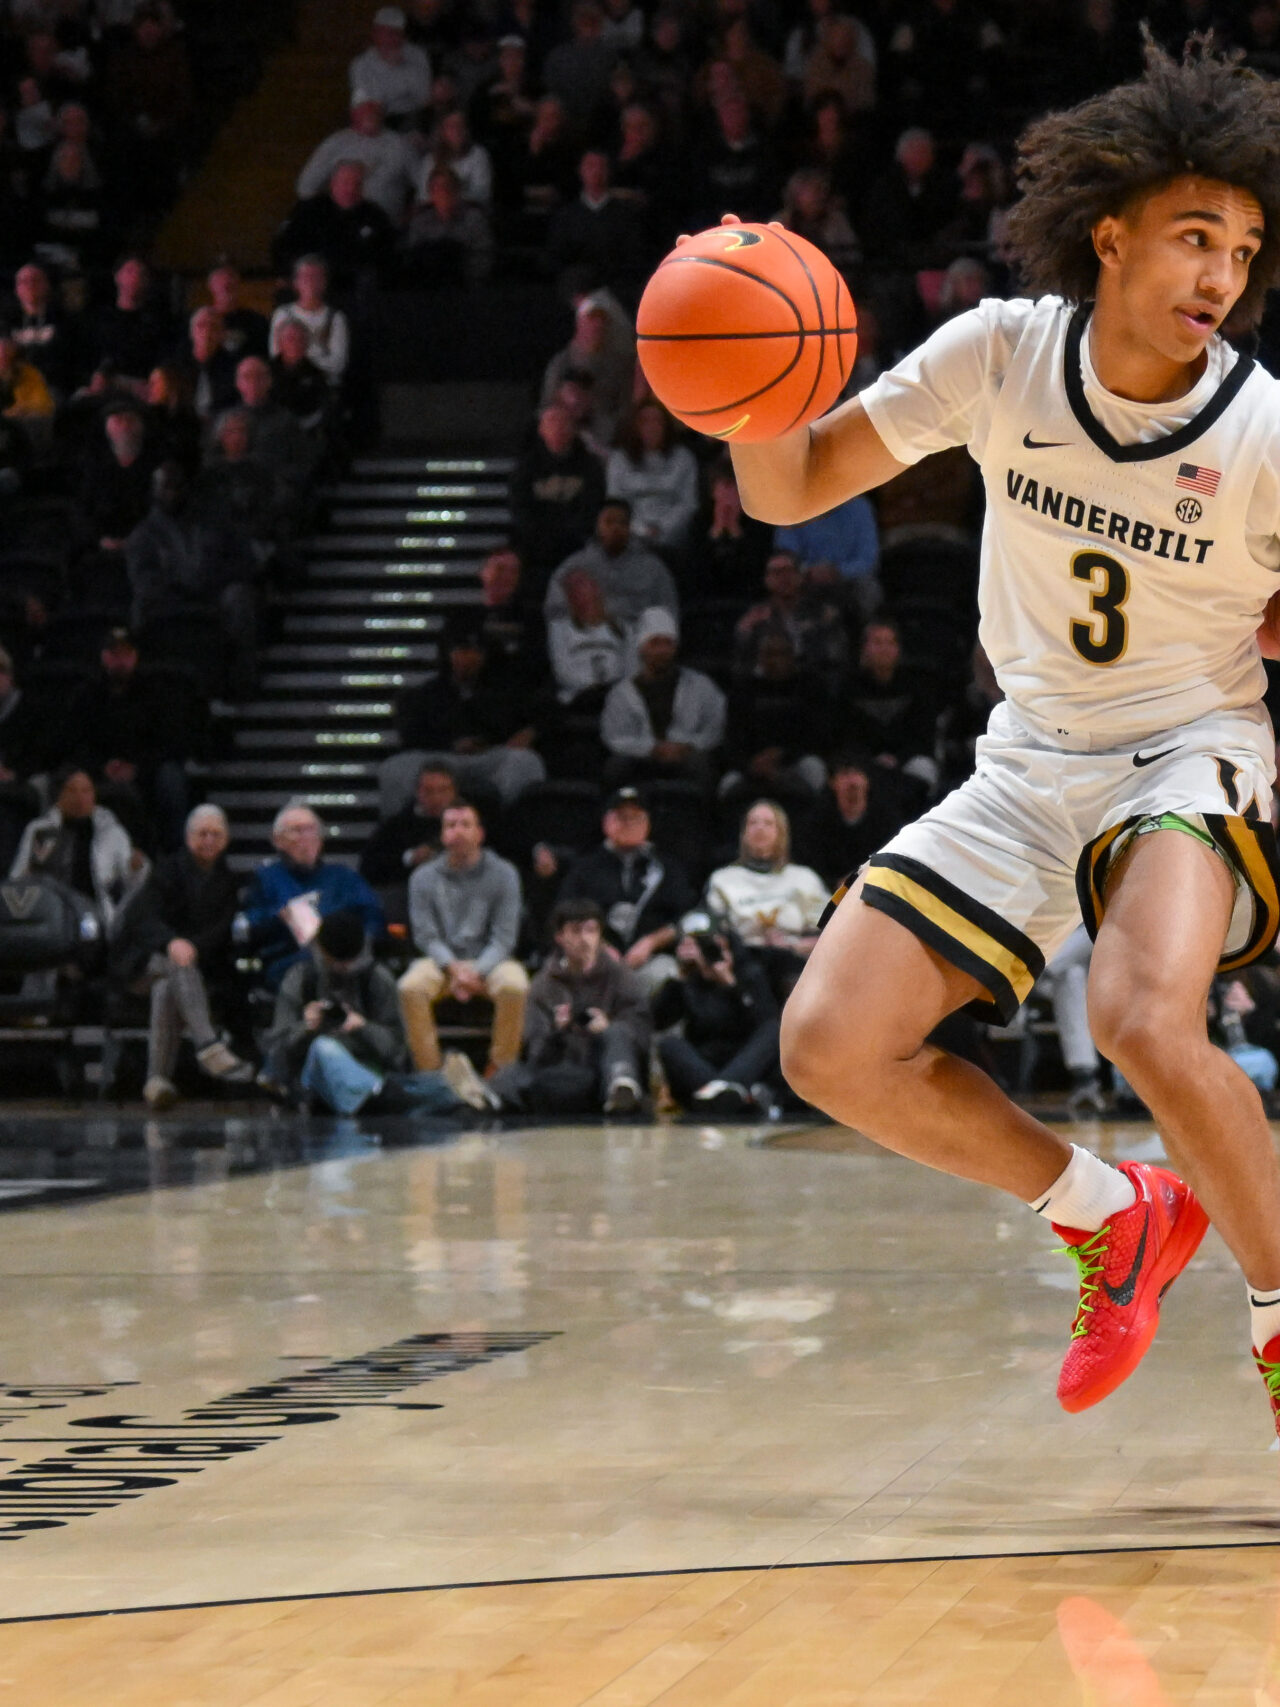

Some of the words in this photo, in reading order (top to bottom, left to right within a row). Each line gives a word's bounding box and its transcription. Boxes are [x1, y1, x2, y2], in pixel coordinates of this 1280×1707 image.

[1007, 468, 1215, 565] VANDERBILT
[1178, 499, 1201, 523] SEC
[1069, 548, 1132, 667] 3
